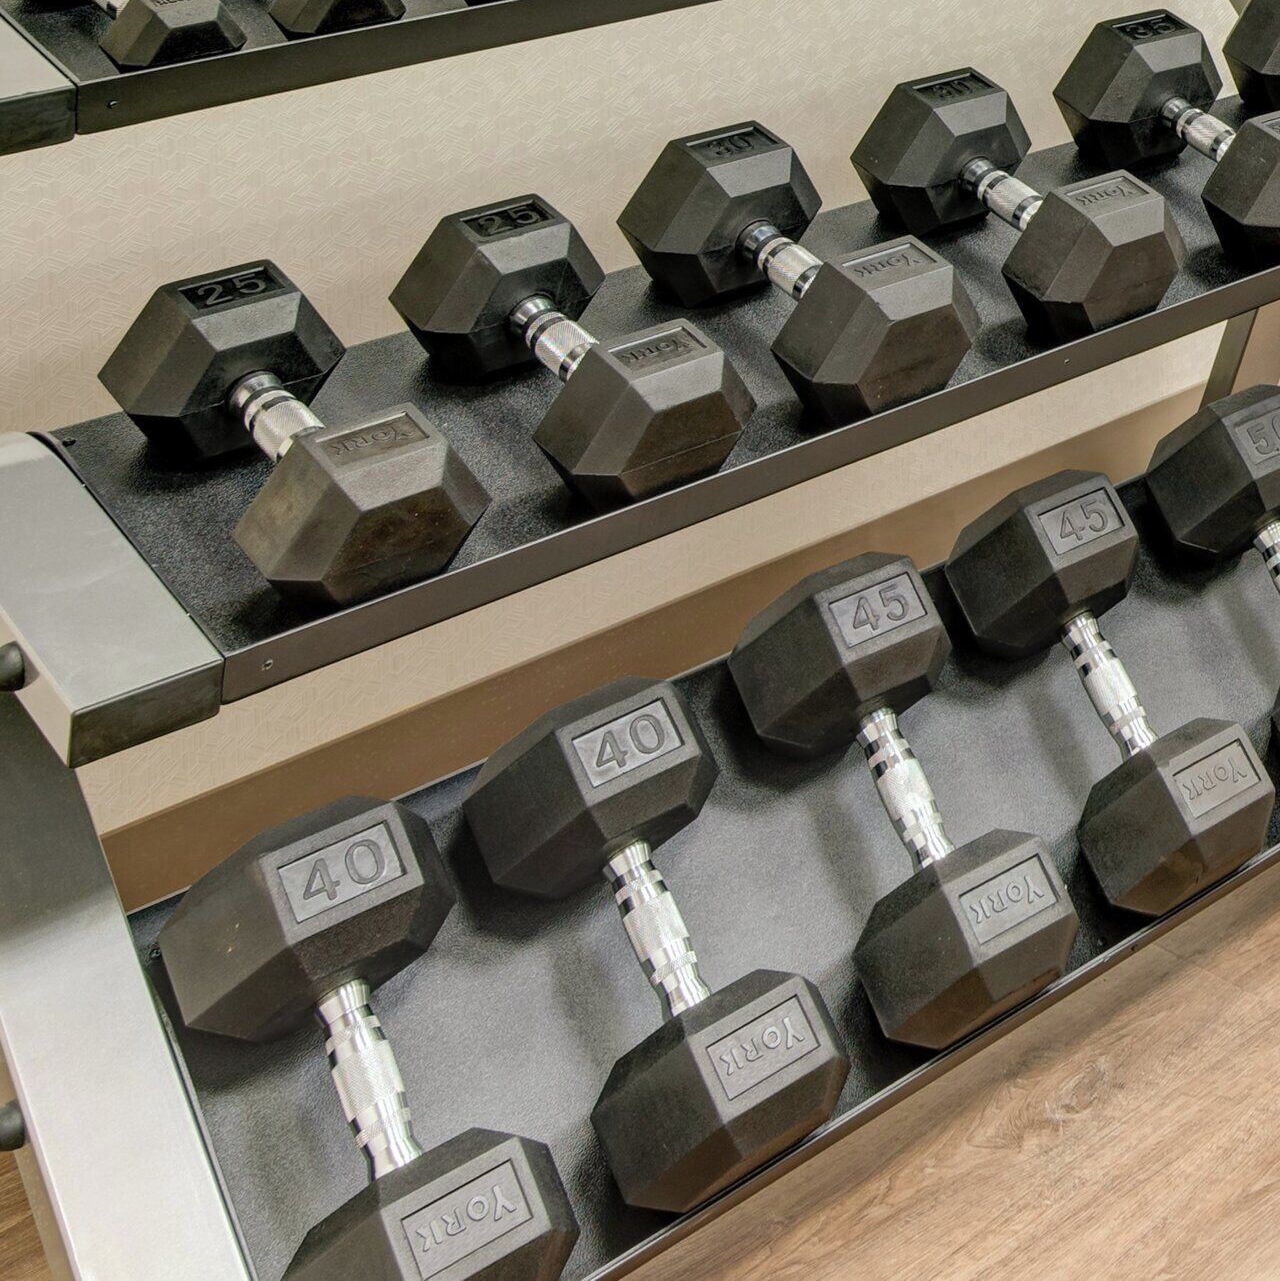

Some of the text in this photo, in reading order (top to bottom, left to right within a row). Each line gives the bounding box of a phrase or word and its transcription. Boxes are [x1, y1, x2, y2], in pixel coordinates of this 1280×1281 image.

[1126, 18, 1176, 41] 35
[930, 79, 971, 101] 30
[708, 135, 752, 156] 30
[478, 207, 543, 236] 25
[198, 273, 266, 307] 25
[1058, 499, 1110, 541] 45
[852, 584, 910, 633] 45
[595, 713, 665, 770] 40
[302, 838, 385, 902] 40
